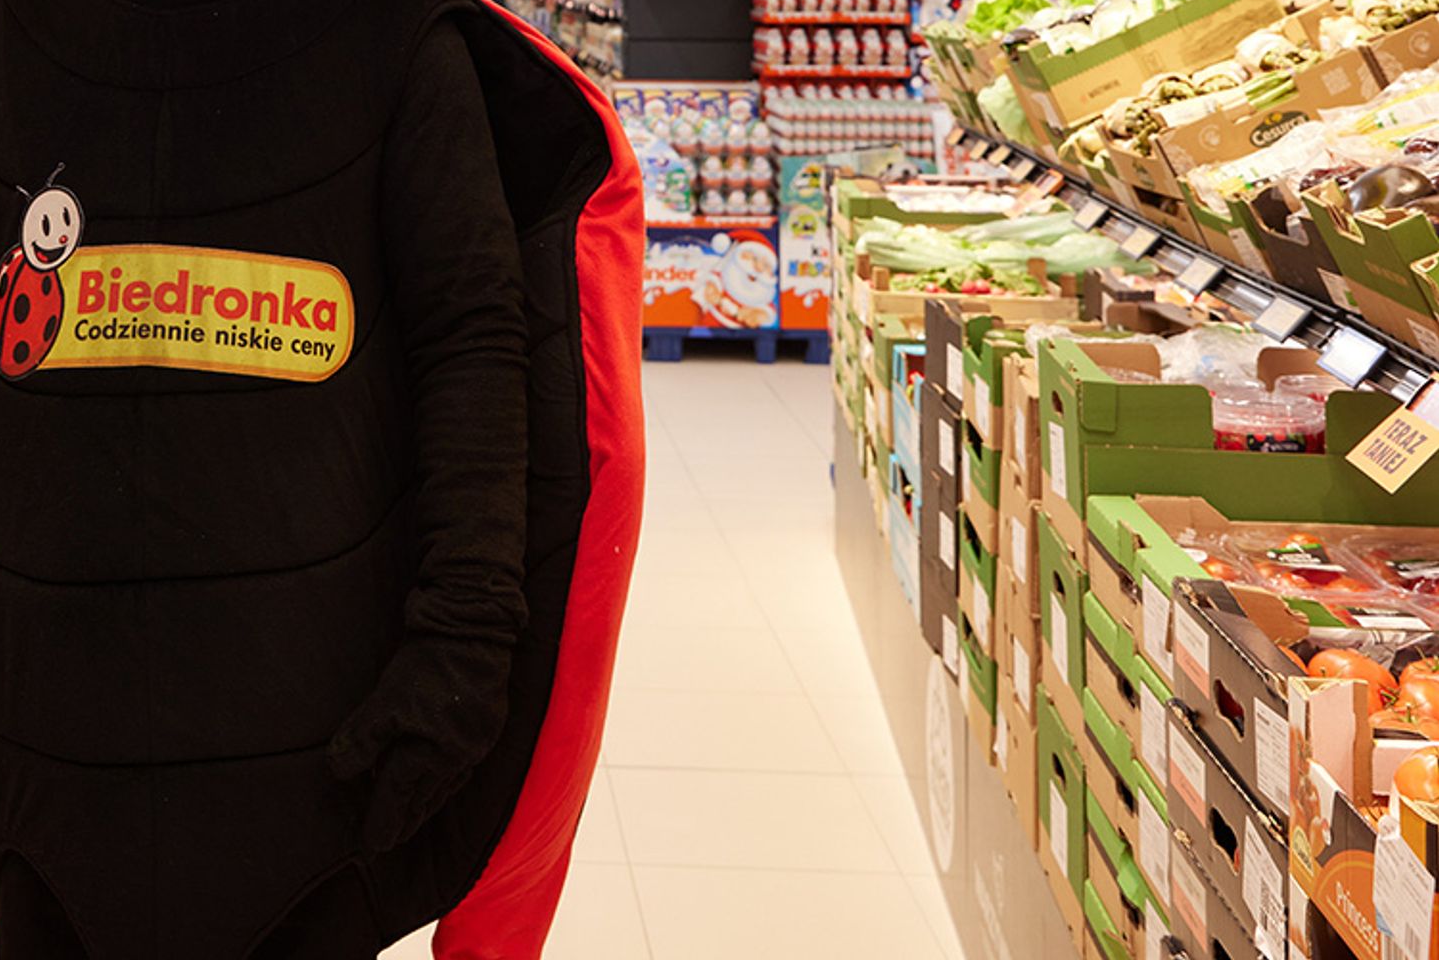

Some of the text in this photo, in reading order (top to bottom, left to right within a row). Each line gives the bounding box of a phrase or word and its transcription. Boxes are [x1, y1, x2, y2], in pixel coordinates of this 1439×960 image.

[77, 268, 337, 331] Biedronka
[74, 320, 336, 361] Codziennie niskie ceny
[1364, 438, 1407, 474] TANIEJ
[1384, 418, 1428, 455] TERAZ
